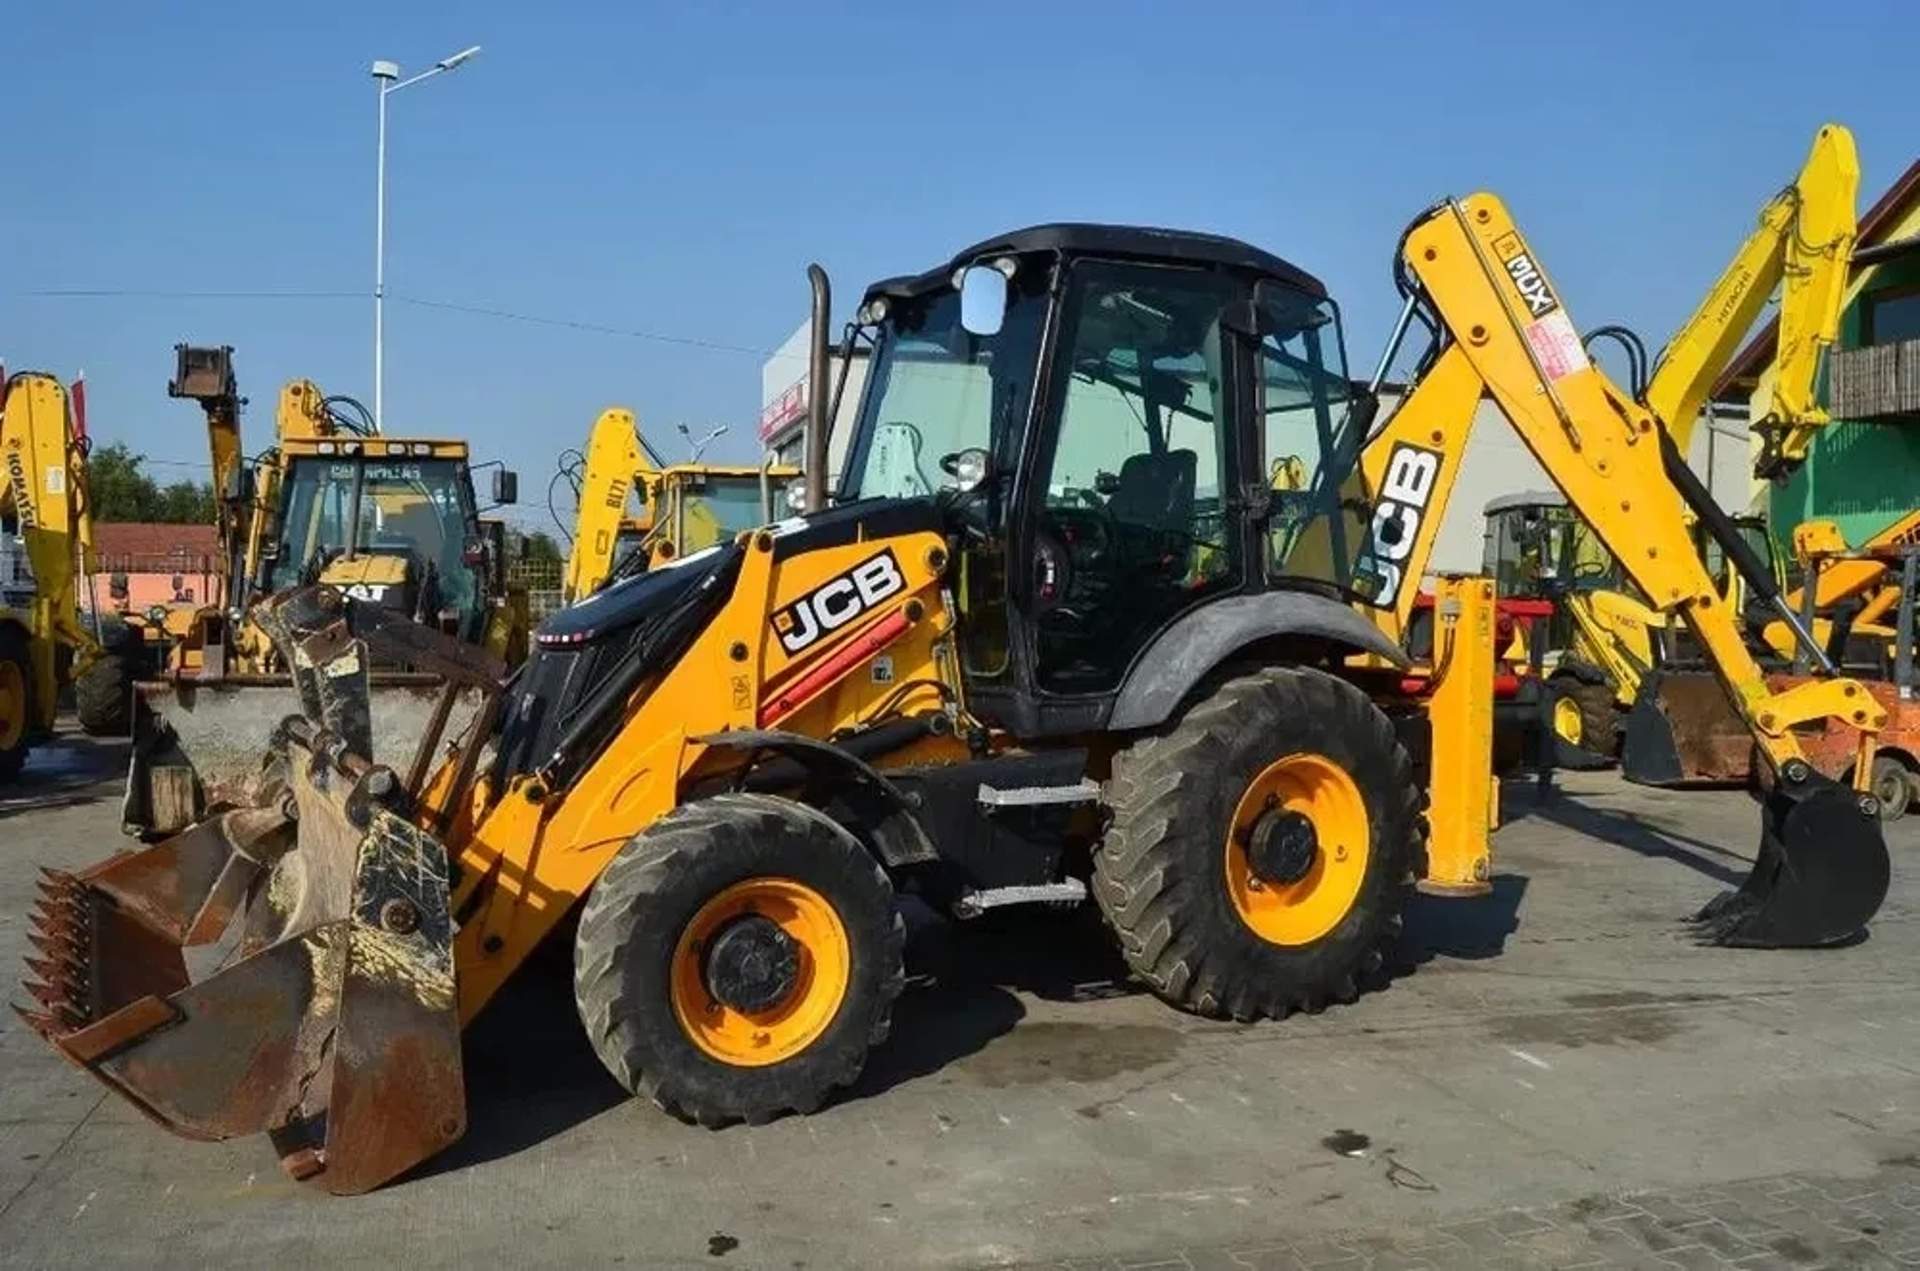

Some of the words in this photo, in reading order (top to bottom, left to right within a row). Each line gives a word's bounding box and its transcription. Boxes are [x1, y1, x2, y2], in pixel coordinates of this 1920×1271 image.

[1716, 271, 1752, 323] HITACHI
[8, 453, 40, 529] KOMATSU
[606, 479, 627, 509] BL71
[1372, 448, 1438, 606] JCB
[782, 554, 903, 651] JCB
